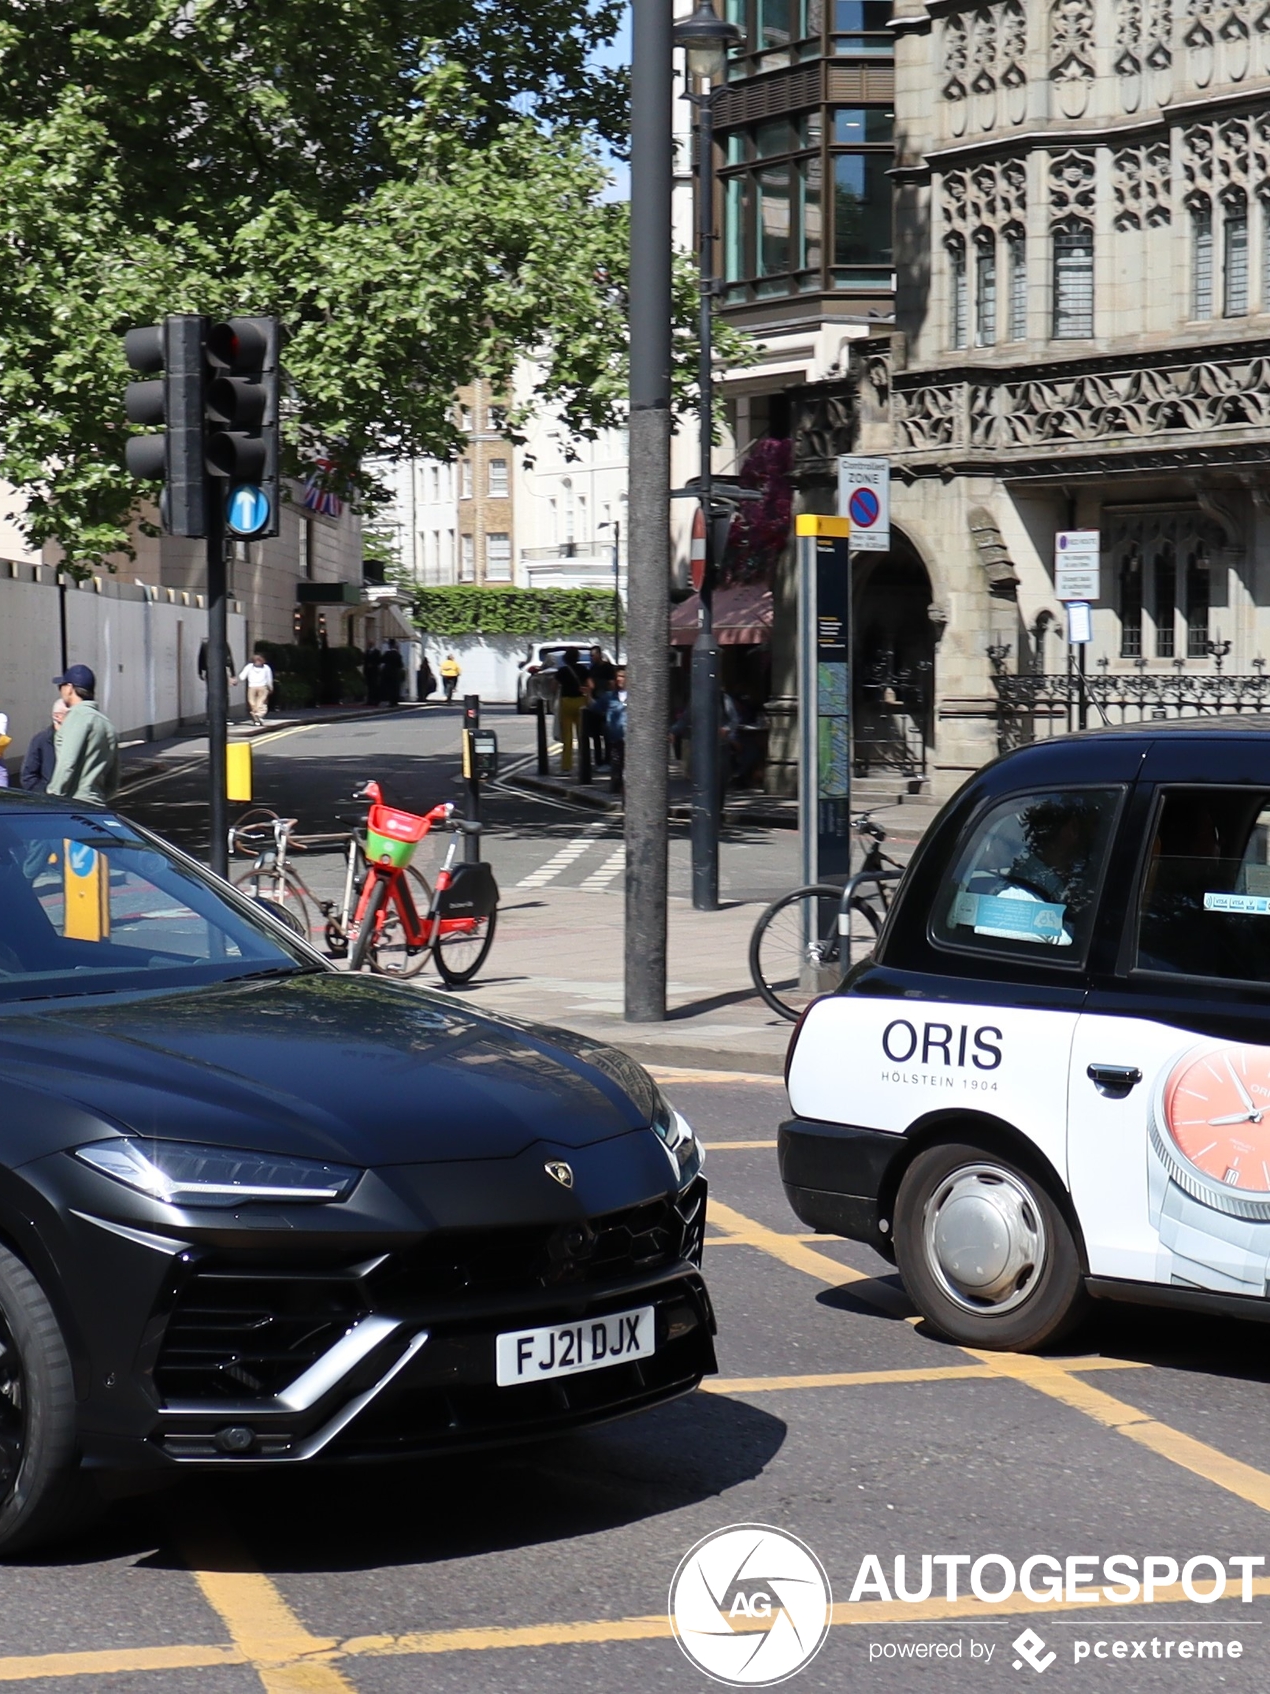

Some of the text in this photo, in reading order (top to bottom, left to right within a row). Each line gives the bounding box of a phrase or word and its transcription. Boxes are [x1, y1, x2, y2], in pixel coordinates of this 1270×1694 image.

[842, 461, 886, 471] Controlled
[848, 472, 880, 485] ZONE
[882, 1018, 1003, 1071] ORIS
[881, 1070, 998, 1092] HÖLSTEIN 1904
[517, 1315, 640, 1375] FJ21 DJX
